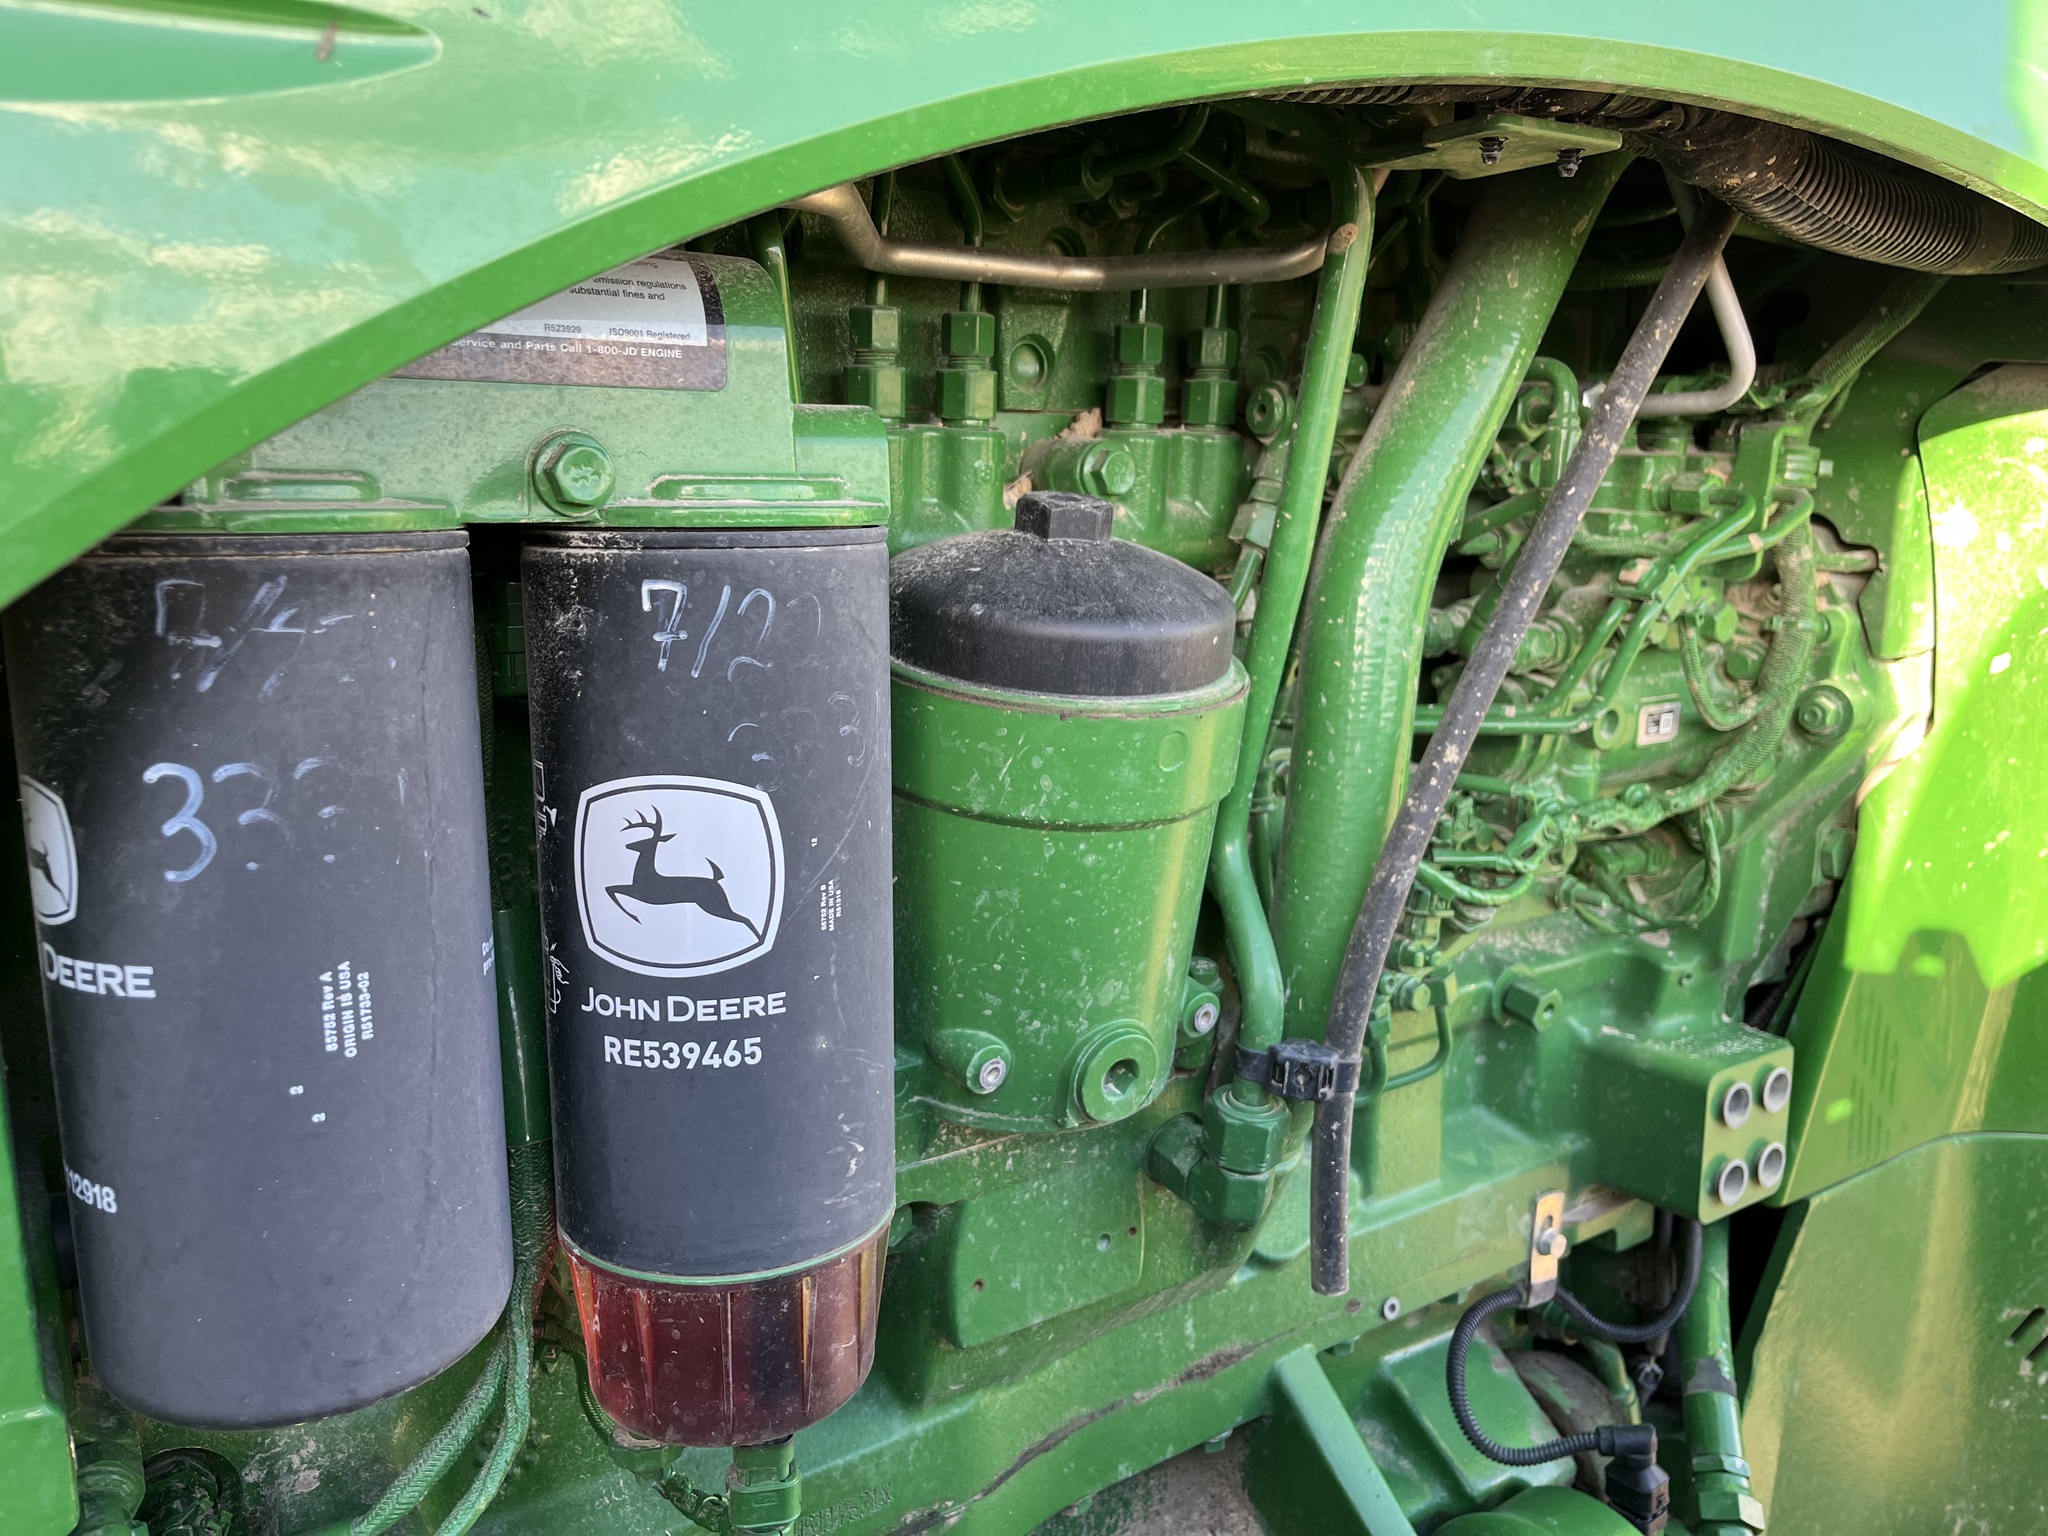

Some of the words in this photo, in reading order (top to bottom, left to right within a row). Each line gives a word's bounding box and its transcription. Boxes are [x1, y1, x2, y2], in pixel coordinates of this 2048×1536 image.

[622, 288, 646, 299] fines
[647, 291, 666, 301] and
[636, 279, 688, 291] regulations
[544, 322, 582, 334] R523929
[608, 327, 643, 338] ISO9001
[646, 329, 691, 341] Registered
[500, 339, 522, 350] and
[525, 340, 557, 352] Parts
[560, 342, 582, 354] Call
[586, 344, 637, 356] 1-800-JD
[640, 347, 683, 359] ENGINE
[41, 941, 156, 998] DEERE
[318, 971, 333, 982] A
[337, 960, 352, 990] USA
[321, 985, 336, 1011] Rev
[340, 992, 354, 1007] IS
[581, 986, 661, 1022] JOHN
[666, 991, 787, 1022] DEERE
[341, 1009, 358, 1058] ORIGIN
[603, 1035, 763, 1070] RE539465
[289, 1084, 304, 1095] 2
[311, 1112, 326, 1122] 2
